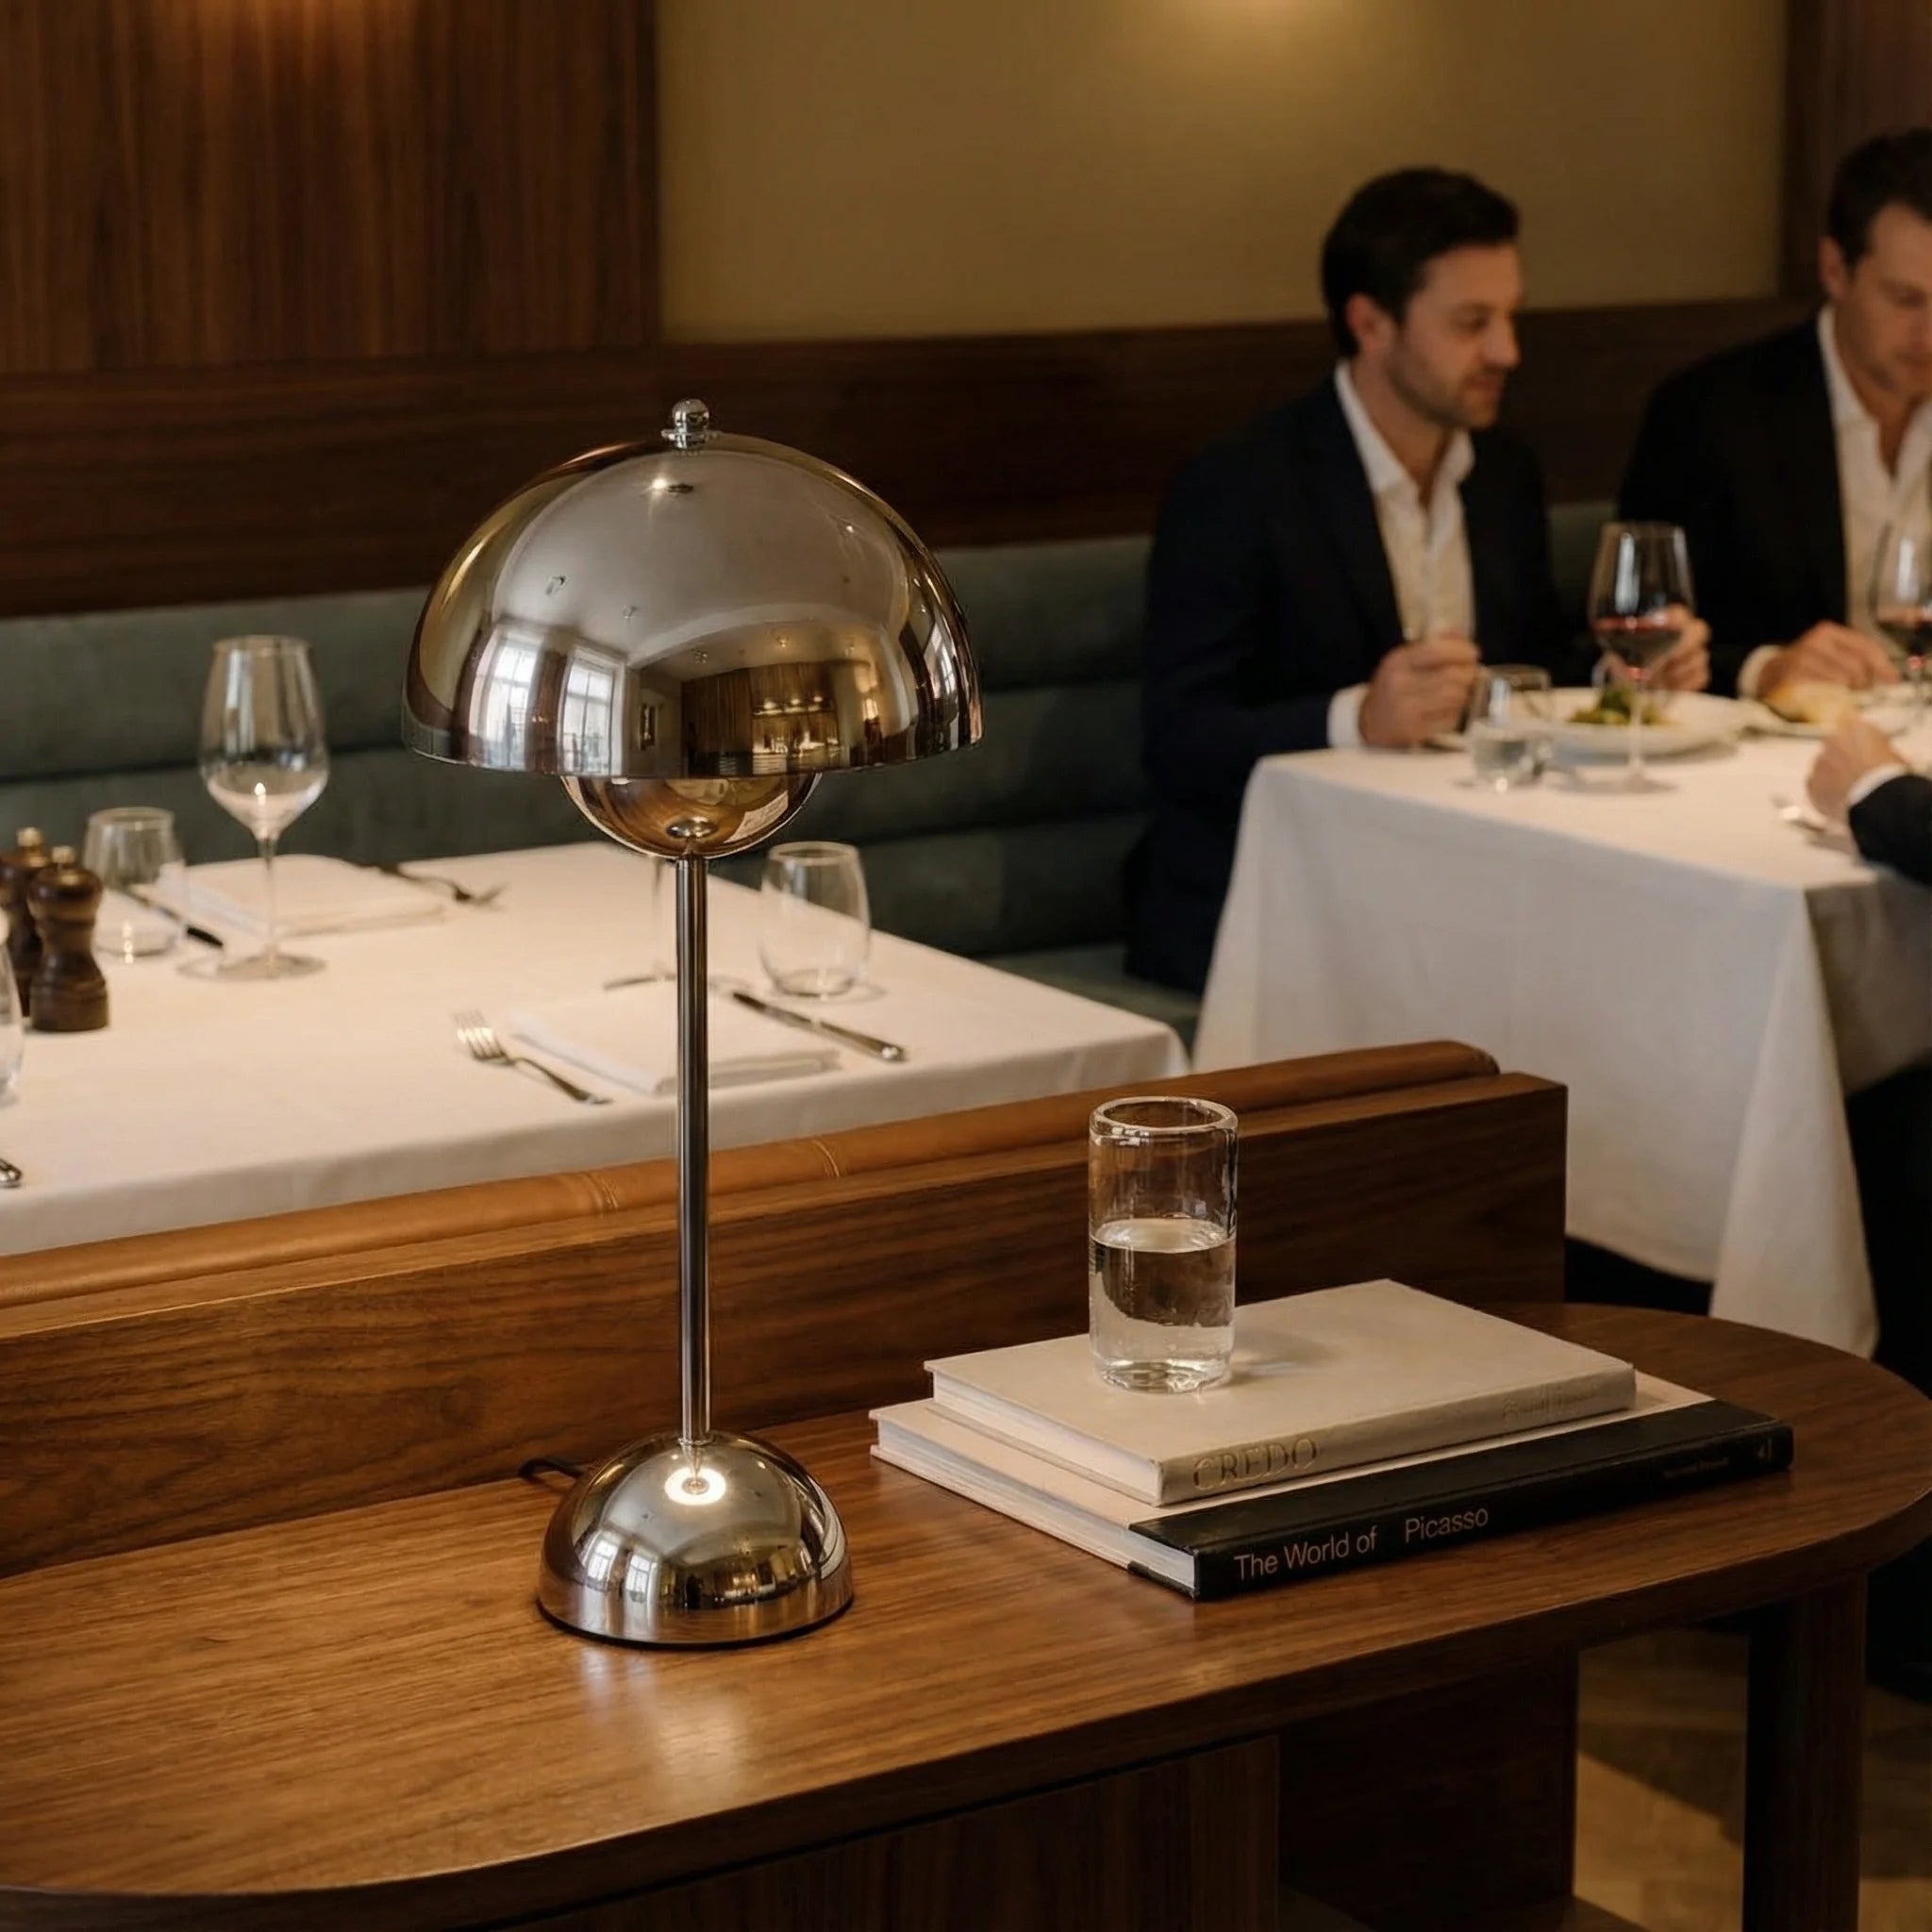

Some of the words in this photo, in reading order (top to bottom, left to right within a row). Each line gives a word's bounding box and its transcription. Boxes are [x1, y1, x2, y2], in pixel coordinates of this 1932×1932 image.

[1193, 1438, 1317, 1489] CREDO
[1234, 1553, 1278, 1580] The
[1284, 1532, 1349, 1569] World
[1357, 1525, 1377, 1554] of
[1405, 1508, 1488, 1542] Picasso
